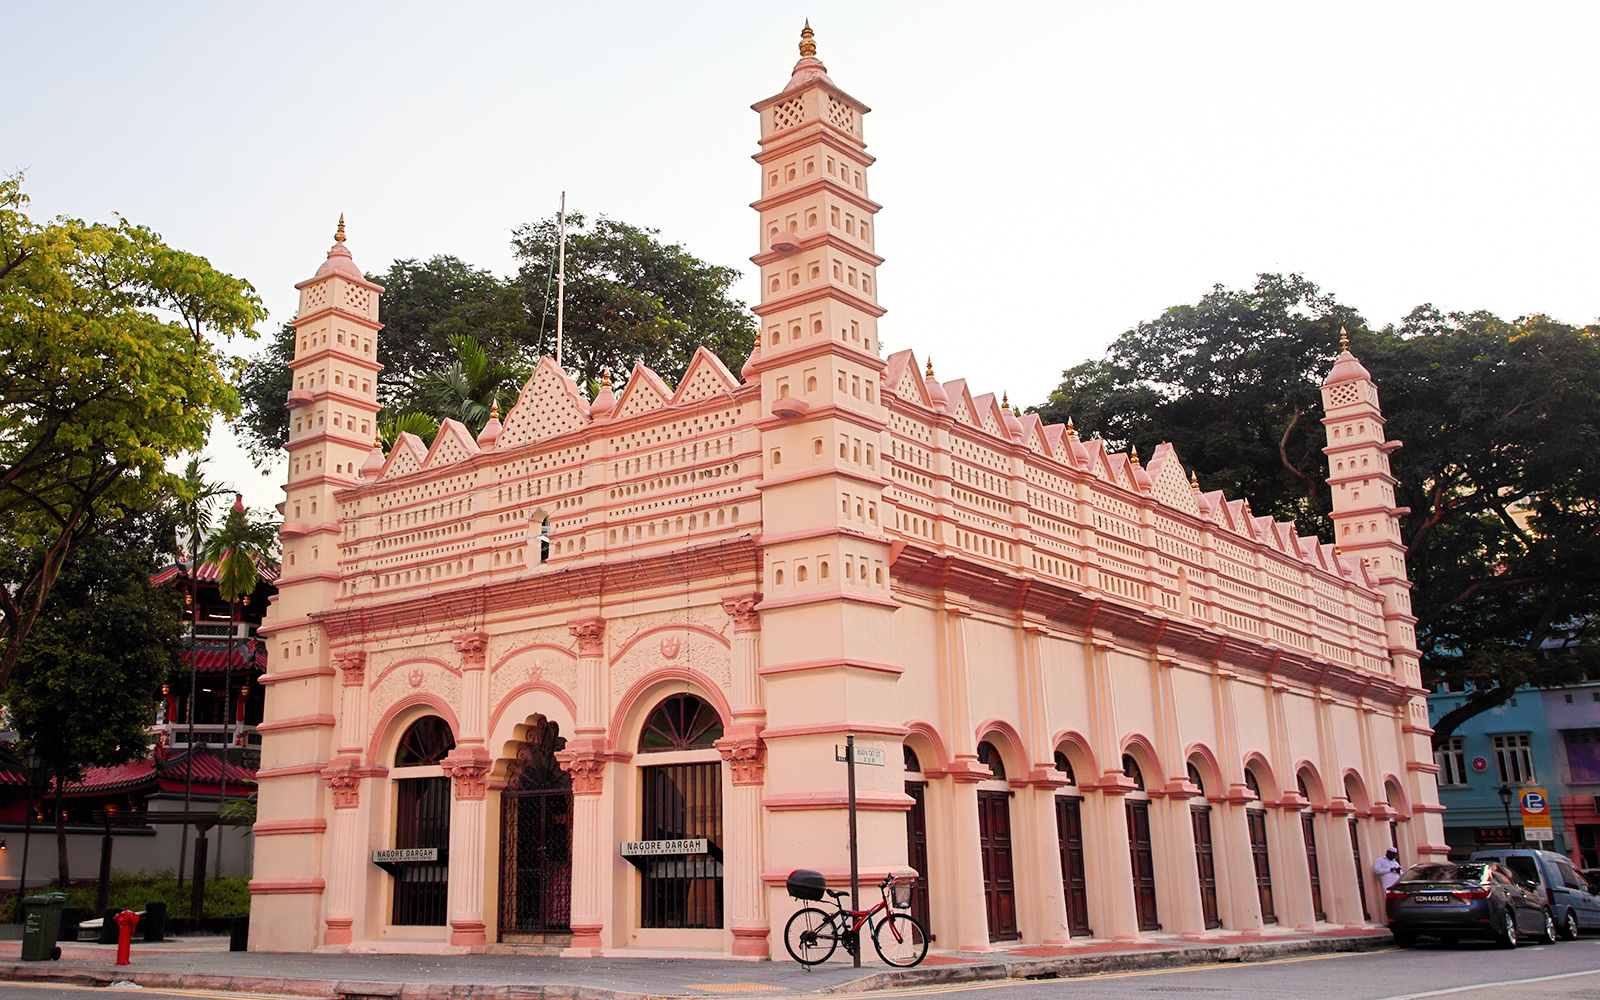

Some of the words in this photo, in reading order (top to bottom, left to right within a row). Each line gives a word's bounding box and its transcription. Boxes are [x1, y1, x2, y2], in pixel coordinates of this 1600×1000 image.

[1526, 793, 1542, 808] P
[627, 842, 661, 850] NAGORE
[665, 840, 701, 849] DARGAH
[377, 850, 403, 858] NAGORE
[405, 849, 433, 857] DARGAH
